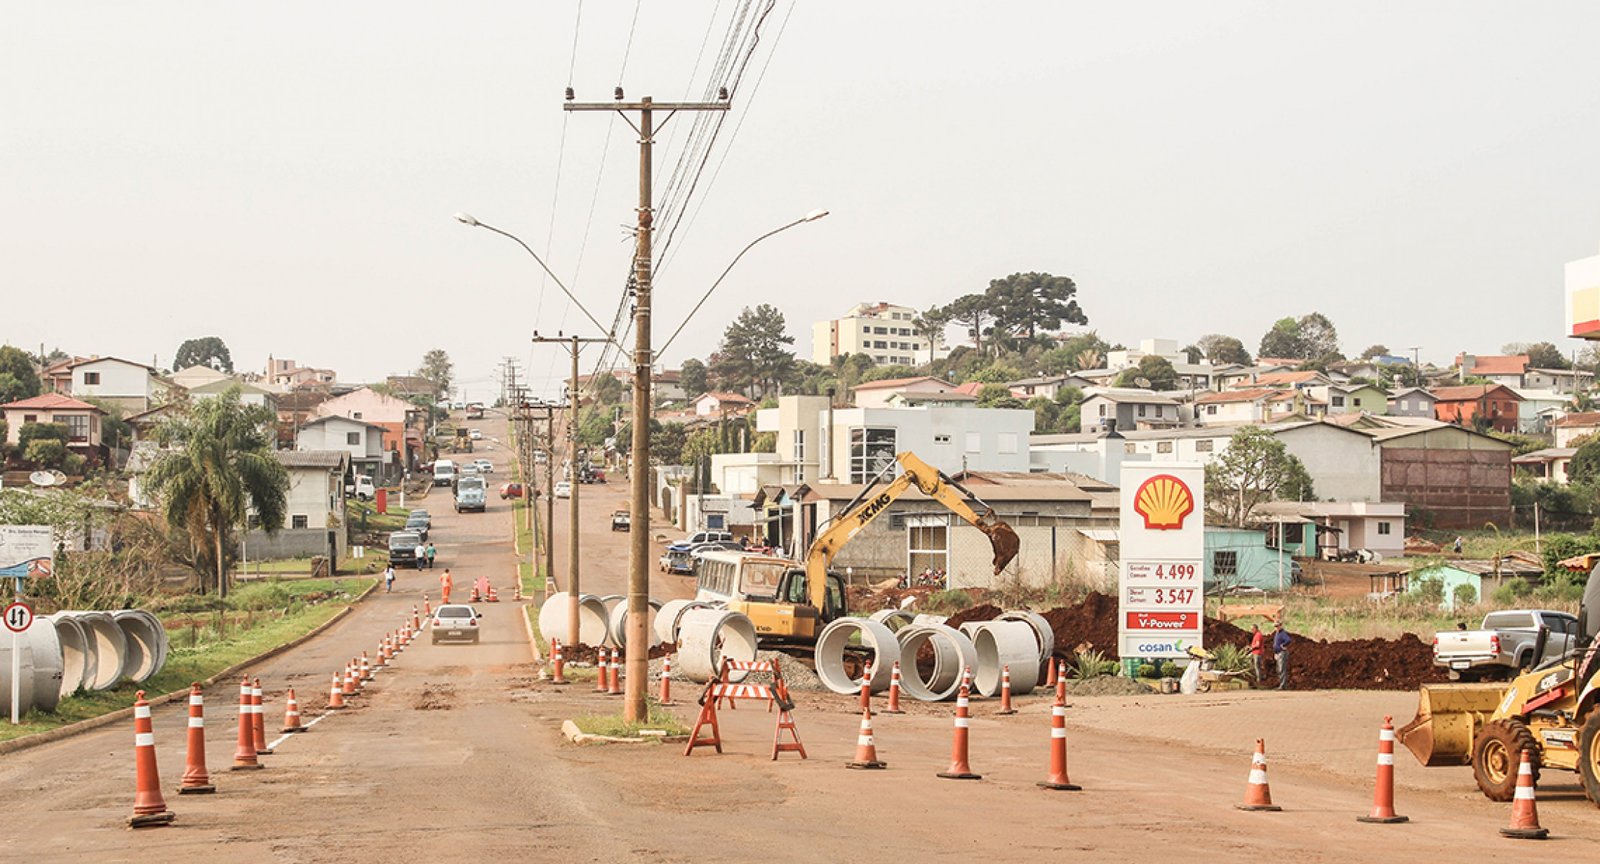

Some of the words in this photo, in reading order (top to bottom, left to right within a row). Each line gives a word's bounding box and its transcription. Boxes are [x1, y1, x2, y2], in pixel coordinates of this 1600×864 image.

[856, 493, 891, 525] XCMG
[1155, 564, 1194, 579] 4.499
[1155, 588, 1194, 604] 3.547
[1138, 618, 1185, 628] V-Power
[1138, 643, 1173, 652] cosan
